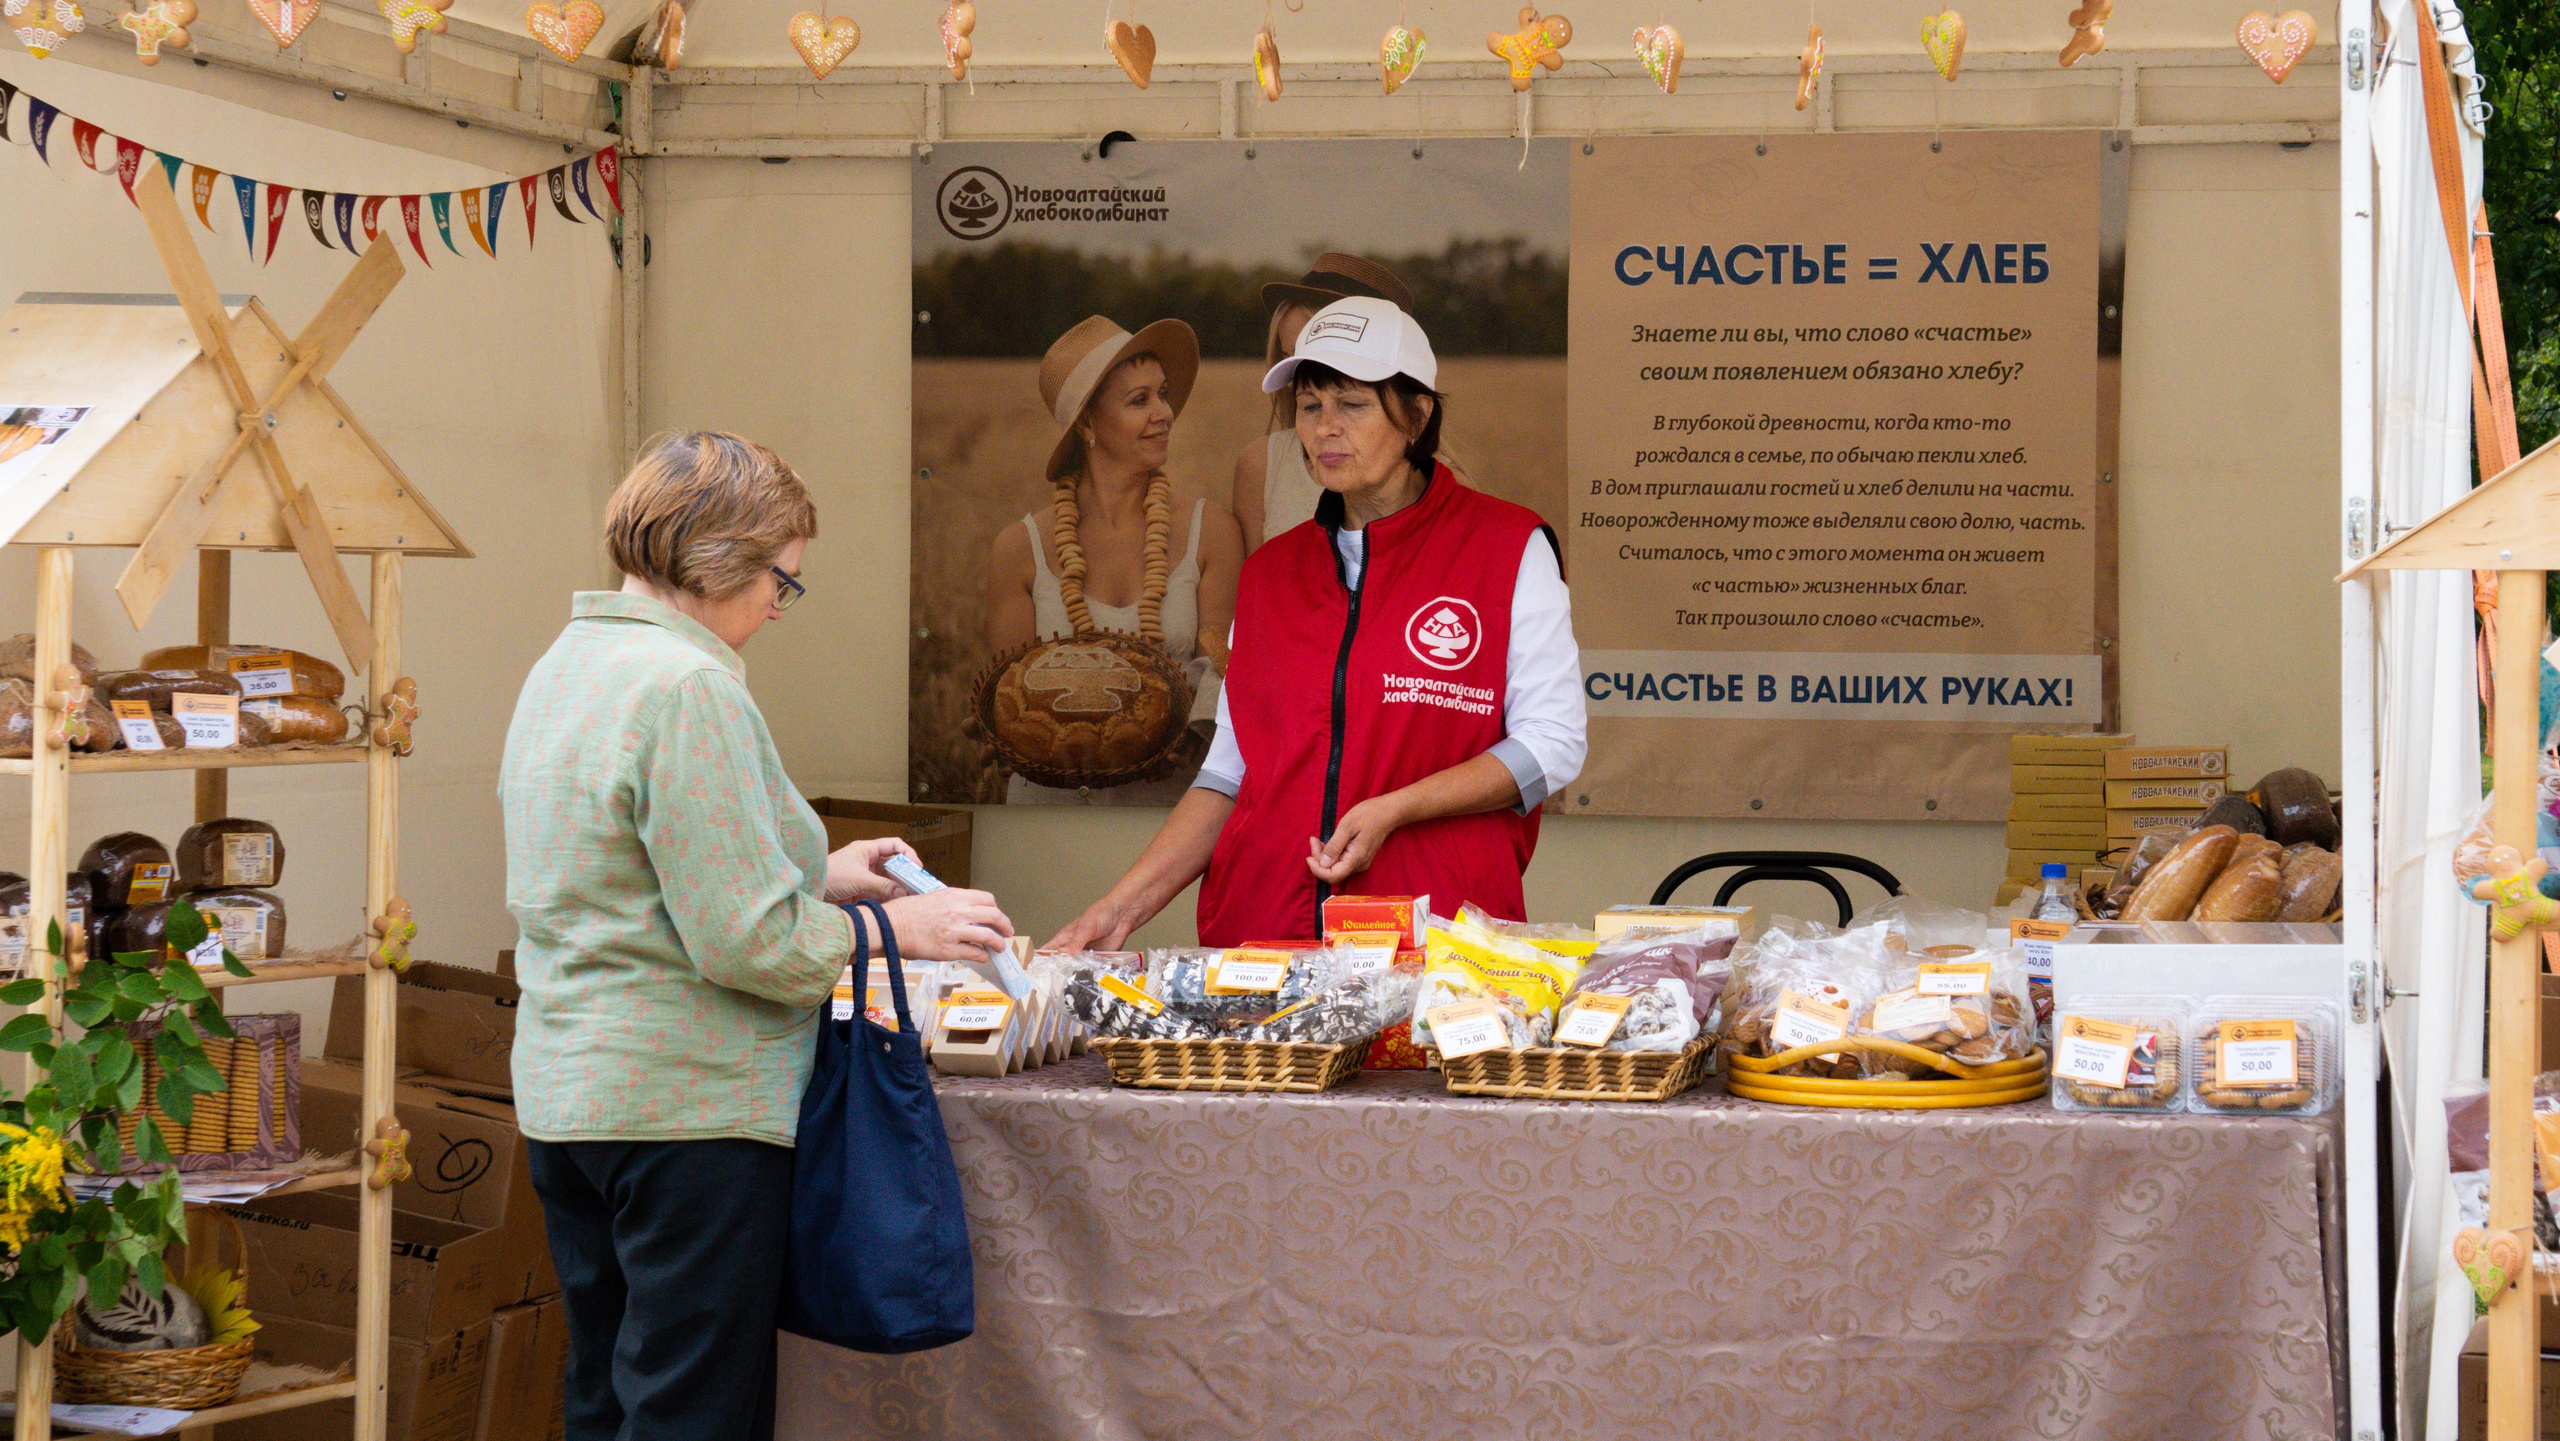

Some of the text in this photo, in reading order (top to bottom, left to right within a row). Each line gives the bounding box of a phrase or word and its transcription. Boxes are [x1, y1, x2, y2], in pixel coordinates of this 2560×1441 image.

[1013, 185, 1166, 202] Новоалтайский
[1012, 203, 1169, 223] хлебокомбинат
[1613, 242, 2050, 287] СЧАСТЬЕ = ХЛЕБ
[1630, 324, 2033, 346] Знаете ли вы, что слово «счастье»
[1639, 359, 2025, 386] своим появлением обязано хлебу?
[1652, 412, 2012, 436] В глубокой древности, когда кто-то
[1633, 445, 2028, 468] рождался в семье, по обычаю пекли хлеб.
[1589, 478, 2075, 501] В дом приглашали гостей и хлеб делили на части.
[1579, 510, 2086, 533] Новорожденному тоже выделяли свою долю, часть.
[1618, 544, 2045, 563] Считалось, что с этого момента он живет
[1691, 577, 1968, 595] «с частью» жизненных благ.
[1675, 609, 1985, 631] Так произошло слово «счастье».
[250, 681, 277, 691] 35,00
[1383, 674, 1494, 701] Новоалтайский
[1584, 671, 2074, 707] СЧАСТЬЕ В ВАШИХ РУКАХ!
[1382, 688, 1494, 715] хлебокомбинат
[192, 729, 219, 739] 50,00
[2132, 755, 2199, 770] НОВОАЛТАЙСКИЙ
[2132, 785, 2199, 799] НОВОАЛТАЙСКИЙ
[2133, 815, 2197, 829] НОВОАЛТАЙСКИ
[1343, 919, 1396, 930] Юбилейное
[1352, 961, 1375, 969] 0,00
[1234, 974, 1268, 982] 100,00
[1574, 1025, 1598, 1036] 75,00
[1790, 1028, 1819, 1043] 50,00
[1457, 1033, 1487, 1046] 75,00
[2074, 1058, 2104, 1072] 50,00
[2242, 1060, 2273, 1071] 50,00
